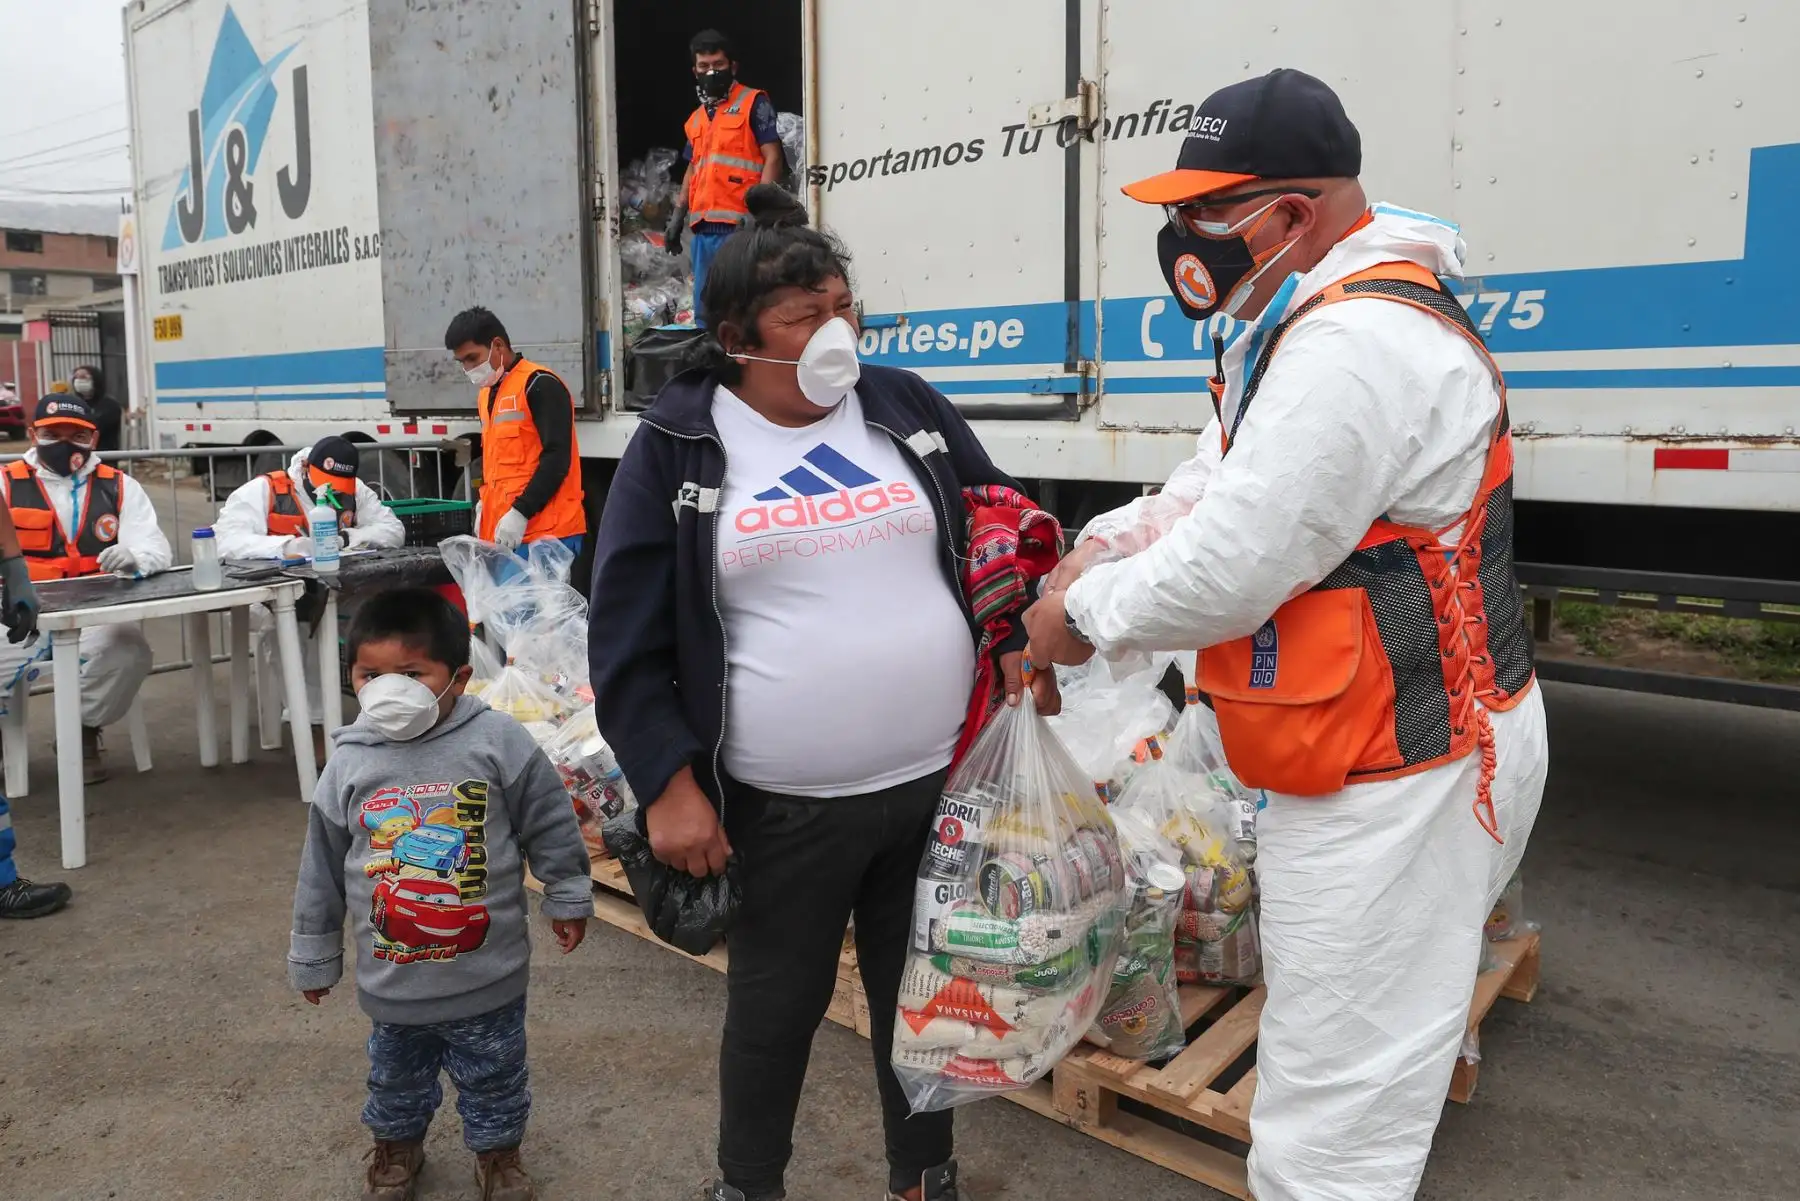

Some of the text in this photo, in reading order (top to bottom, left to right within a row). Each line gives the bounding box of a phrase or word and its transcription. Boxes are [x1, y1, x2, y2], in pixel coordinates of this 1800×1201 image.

[1001, 121, 1042, 158] Tu
[1189, 115, 1228, 136] DECI
[177, 65, 312, 244] J & J
[157, 253, 215, 295] TRANSPORTES
[214, 253, 222, 286] Y
[222, 240, 283, 284] SOLUCIONES
[284, 225, 351, 273] INTEGRALES
[858, 317, 1025, 359] ortes.pe
[734, 481, 916, 534] adidas
[722, 511, 935, 573] PERFORMANCE
[363, 796, 394, 811] Cars
[937, 798, 981, 830] GLORIA
[930, 839, 965, 863] LECHE
[934, 883, 968, 905] GLO
[935, 1003, 990, 1021] PAISANA
